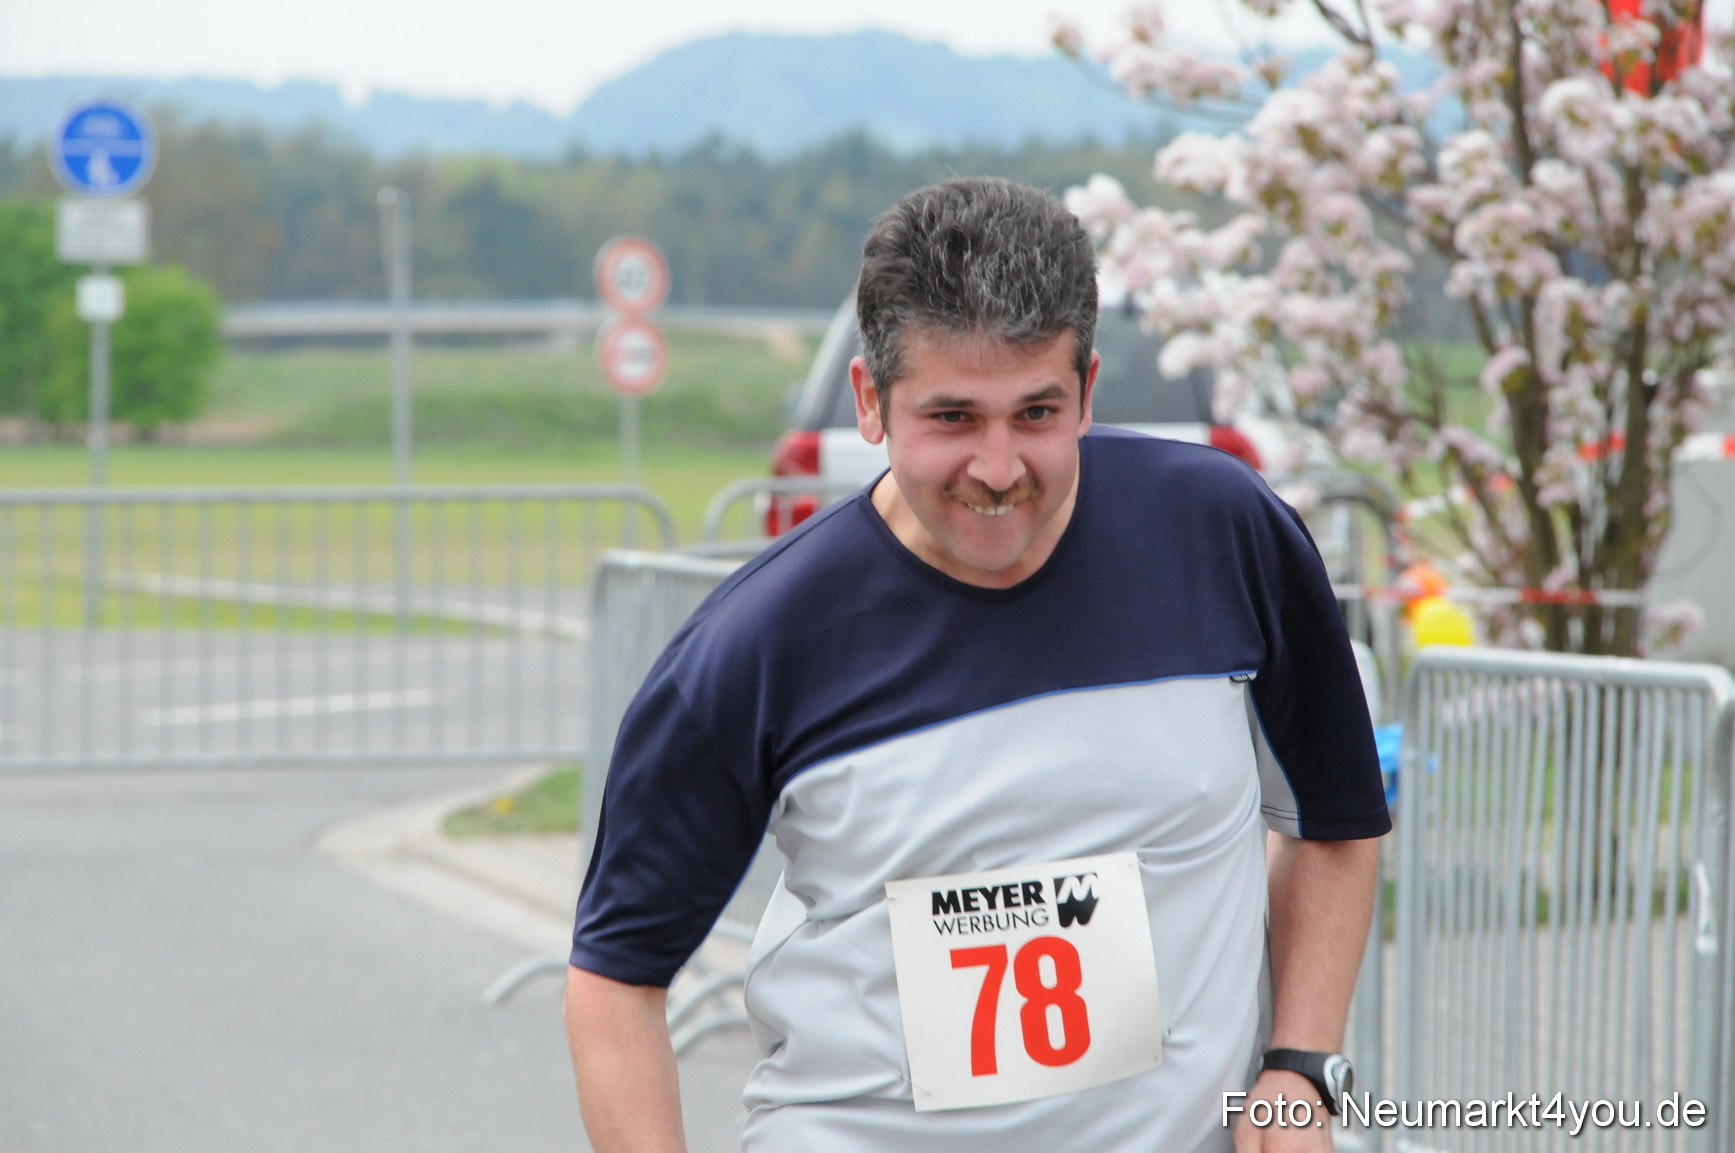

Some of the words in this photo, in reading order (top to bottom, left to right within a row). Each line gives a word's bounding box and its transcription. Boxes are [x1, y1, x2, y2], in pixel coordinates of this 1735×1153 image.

[931, 880, 1046, 916] MEYER
[932, 907, 1050, 936] WERBUNG
[949, 935, 1091, 1078] 78
